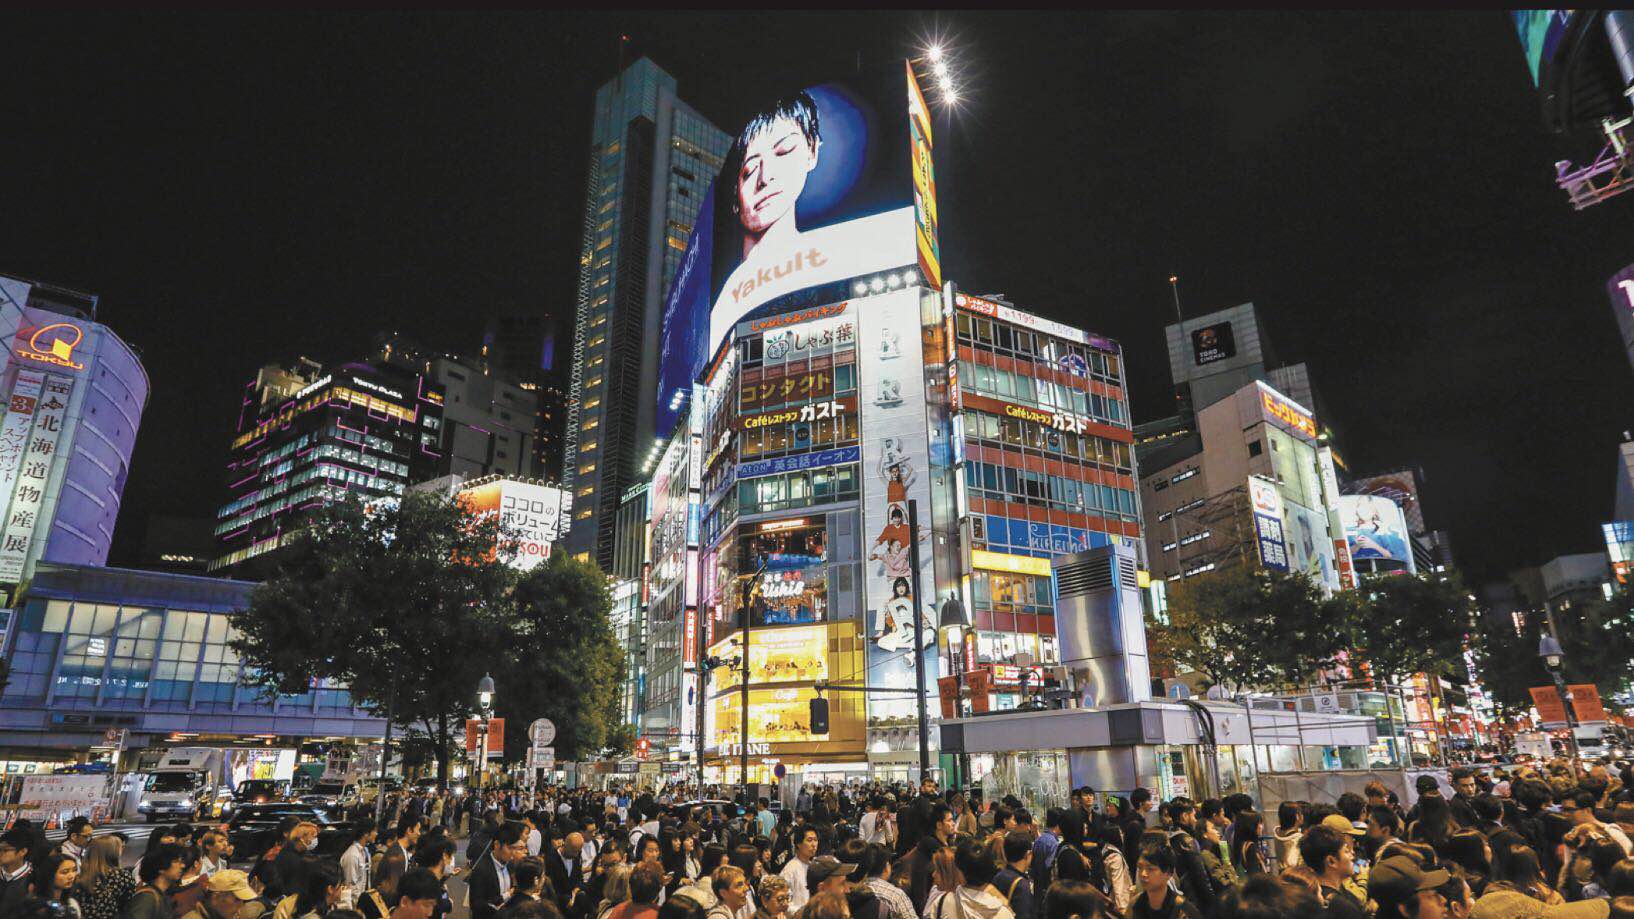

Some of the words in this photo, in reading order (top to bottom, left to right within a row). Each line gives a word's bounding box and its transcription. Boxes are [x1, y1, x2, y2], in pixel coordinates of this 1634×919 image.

[731, 247, 829, 304] Yakult
[16, 350, 84, 369] TOKYU
[741, 373, 831, 403] コンタクト
[800, 401, 845, 422] ガスト
[1052, 413, 1088, 435] ガスト
[774, 449, 858, 472] 英会話イーオン
[4, 415, 60, 553] 北海道物産展
[503, 495, 555, 516] ココロの
[502, 511, 559, 531] ボリューム
